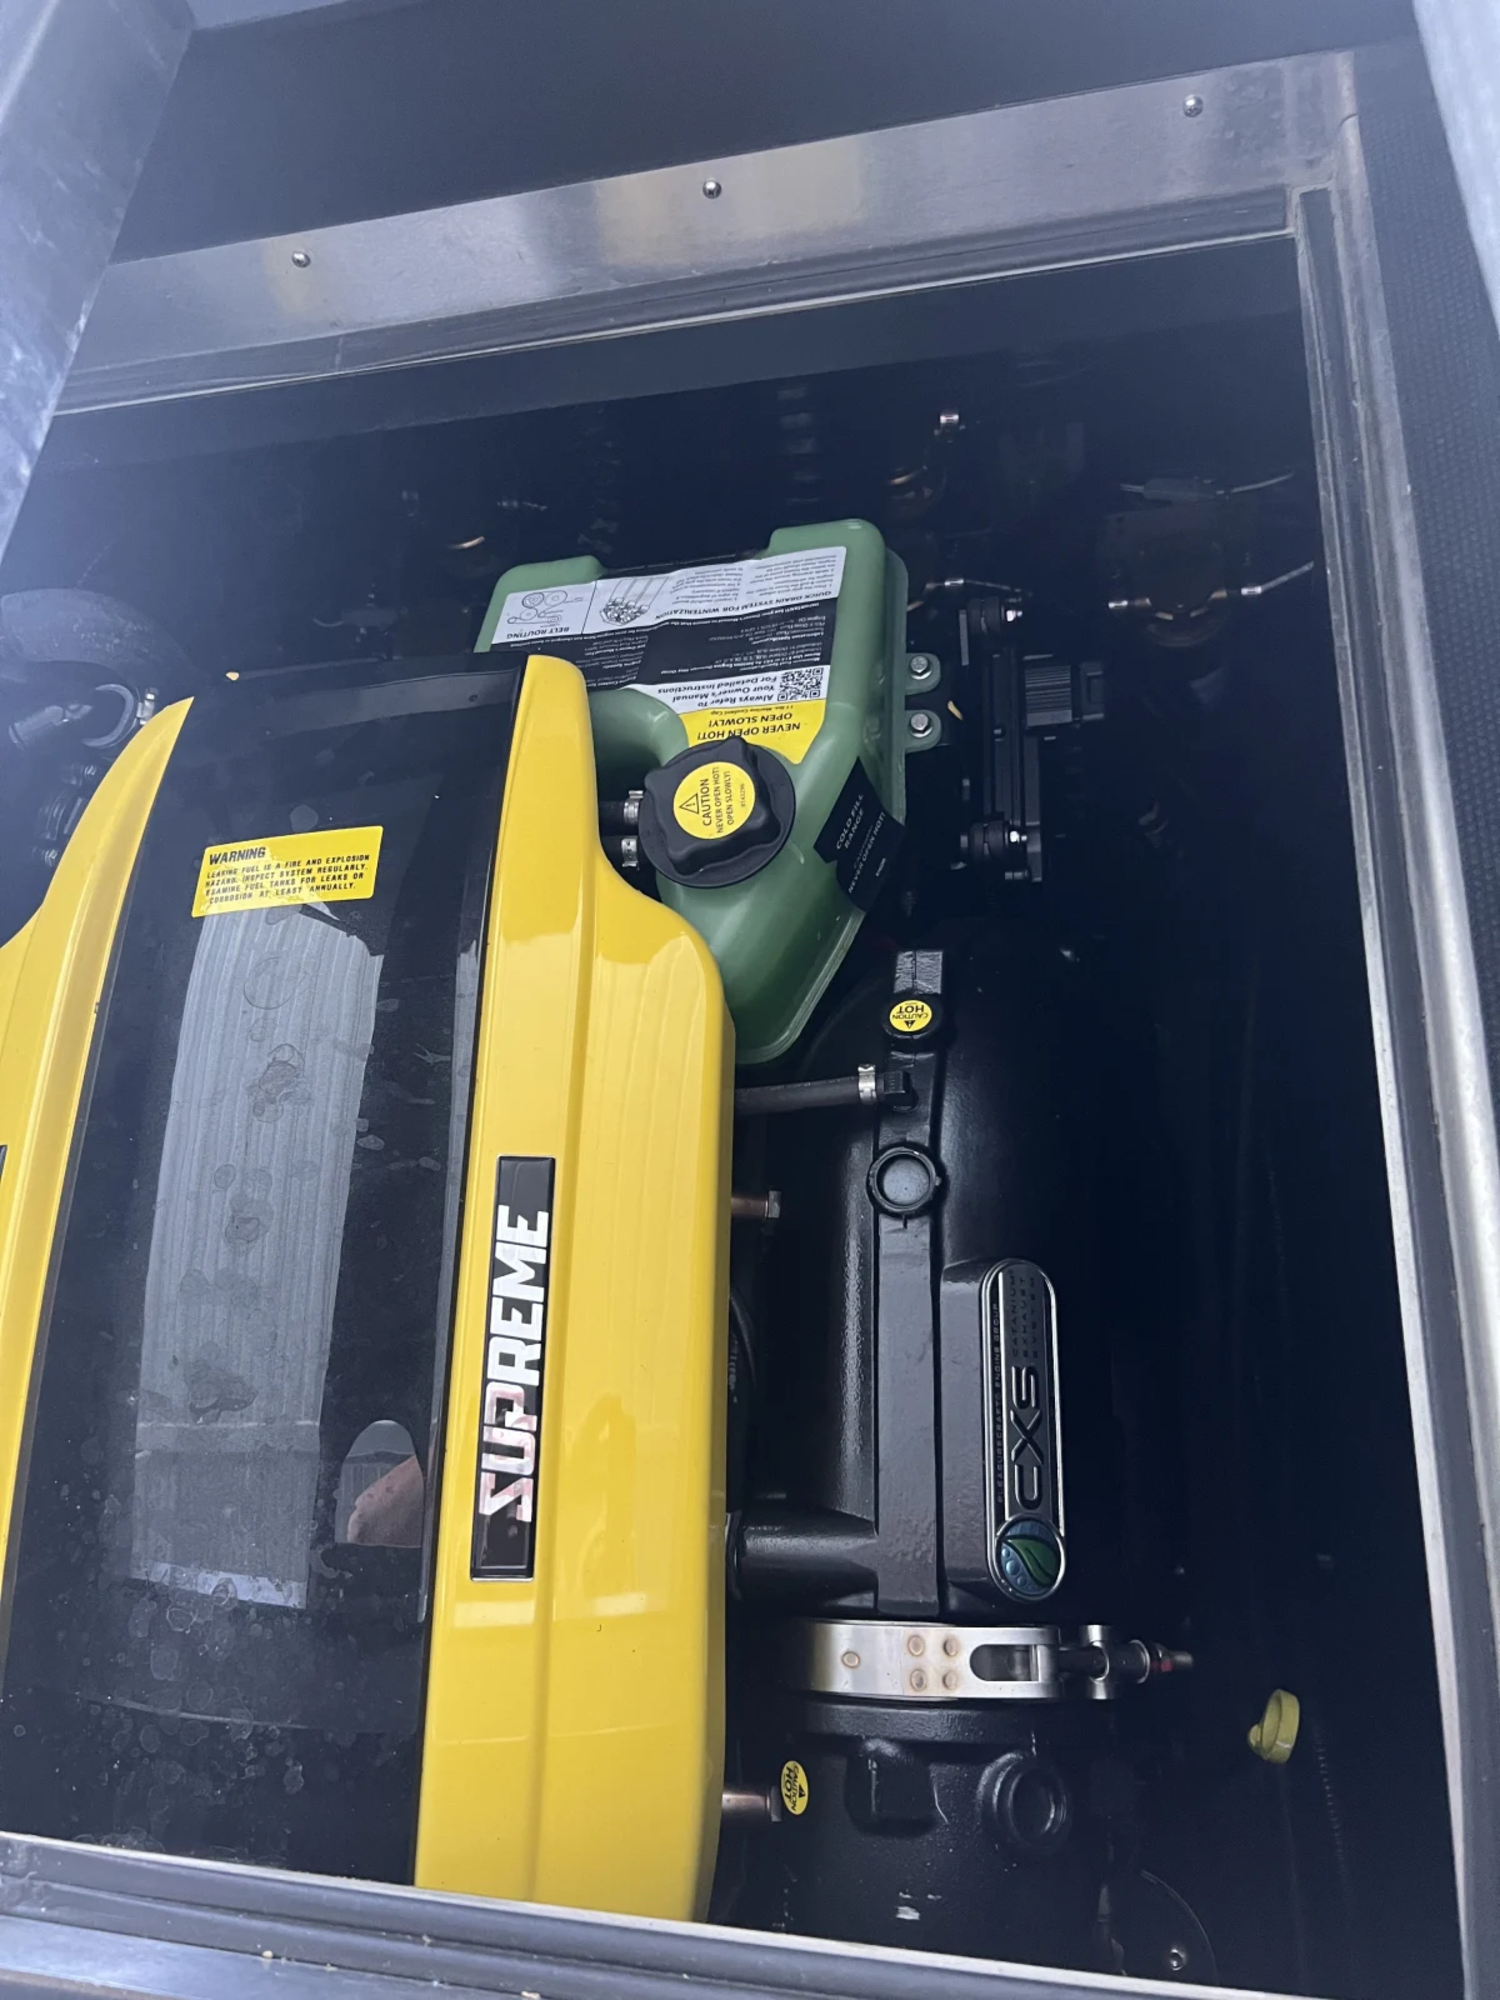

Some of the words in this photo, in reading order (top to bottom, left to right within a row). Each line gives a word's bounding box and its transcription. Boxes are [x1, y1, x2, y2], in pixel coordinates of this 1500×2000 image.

[775, 595, 802, 604] DRAIN
[804, 591, 832, 600] QUICK
[741, 600, 774, 610] SYSTEM
[655, 606, 719, 620] WINTERIZATION
[507, 629, 547, 640] ROUTING
[548, 626, 570, 634] BELT
[717, 677, 760, 689] Detailed
[761, 676, 777, 684] For
[658, 683, 716, 694] Instructions
[711, 687, 751, 697] Owner's
[752, 685, 775, 693] Your
[672, 692, 709, 703] Manual
[697, 700, 708, 708] To
[711, 697, 737, 706] Refer
[738, 694, 775, 703] Always
[708, 715, 759, 727] SLOWLY!
[760, 711, 794, 723] OPEN
[727, 727, 760, 738] OPEN
[762, 722, 801, 734] NEVER
[697, 730, 726, 741] HOT!
[712, 766, 720, 786] HOT!
[723, 770, 732, 804] SLOWLY!
[700, 778, 712, 827] CAUTION
[713, 786, 722, 808] OPEN
[715, 809, 724, 834] NEVER
[725, 804, 734, 826] OPEN
[836, 817, 852, 850] COLD
[850, 794, 864, 818] FILL
[844, 807, 864, 849] RANGE
[209, 846, 267, 866] WARNING
[848, 861, 864, 894] NEVER
[862, 835, 875, 862] OPEN
[872, 811, 886, 836] HOT!
[206, 868, 238, 880] LEAKING
[242, 865, 260, 874] FUEL
[263, 863, 272, 871] IS
[285, 859, 302, 869] FIRE
[305, 858, 322, 866] AND
[325, 854, 370, 865] EXPLOSION
[242, 871, 275, 883] INSPECT
[280, 867, 313, 878] SYSTEM
[316, 863, 369, 875] REGULARLY.
[205, 885, 241, 897] EXAMINE
[244, 882, 265, 891] FUEL
[270, 878, 297, 888] TANKS
[300, 875, 317, 885] FOR
[320, 872, 349, 883] LEAKS
[352, 871, 365, 880] OR
[209, 892, 254, 905] CORROSION
[259, 889, 270, 898] AT
[275, 886, 302, 897] LEAST
[309, 881, 356, 893] ANNUALLY.
[892, 1012, 930, 1020] CAUTION
[896, 1004, 925, 1015] HOT
[992, 1303, 1000, 1342] GROUP
[478, 1204, 550, 1523] SUPREME
[994, 1346, 1002, 1389] ENGINE
[1009, 1365, 1044, 1510] CXS
[783, 1766, 793, 1804] HOT
[790, 1765, 800, 1812] CAUTION
